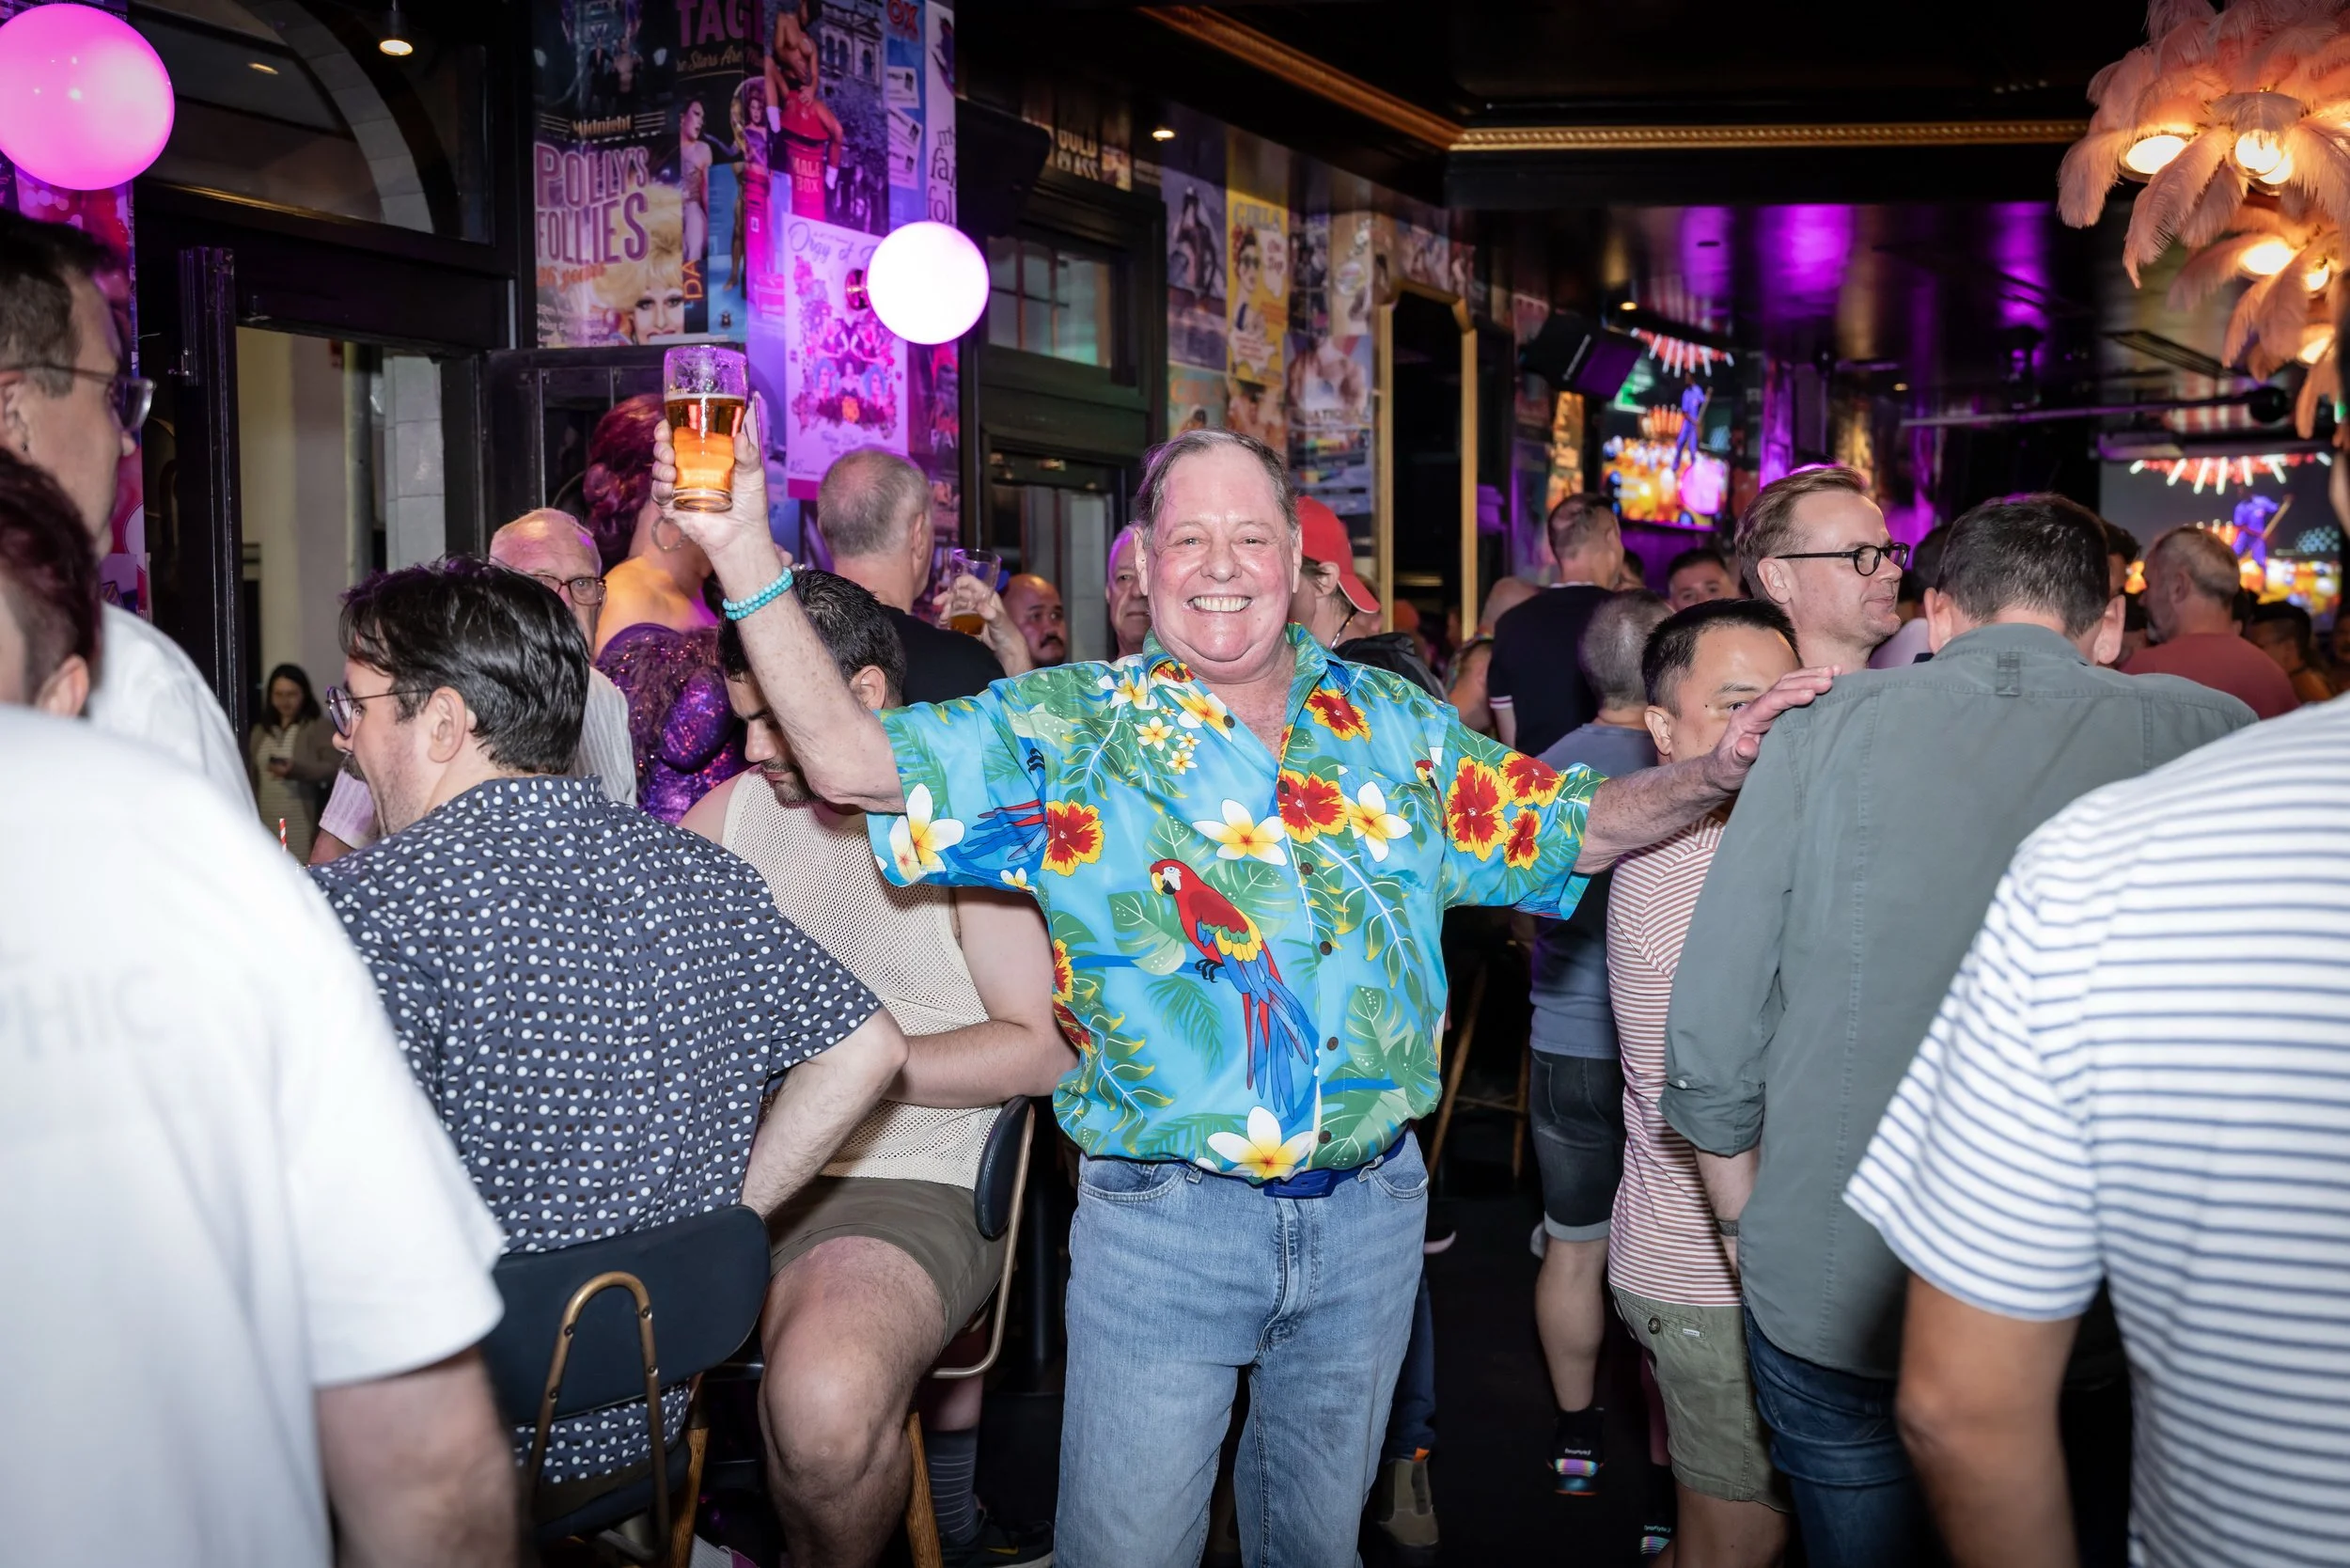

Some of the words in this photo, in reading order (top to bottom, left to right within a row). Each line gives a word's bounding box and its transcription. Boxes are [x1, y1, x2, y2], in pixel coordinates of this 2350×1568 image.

[533, 141, 649, 209] POLLY'S
[795, 176, 819, 194] BOX
[537, 192, 650, 266] FOLLIES
[788, 221, 831, 264] Orgy
[0, 964, 170, 1063] HIC
